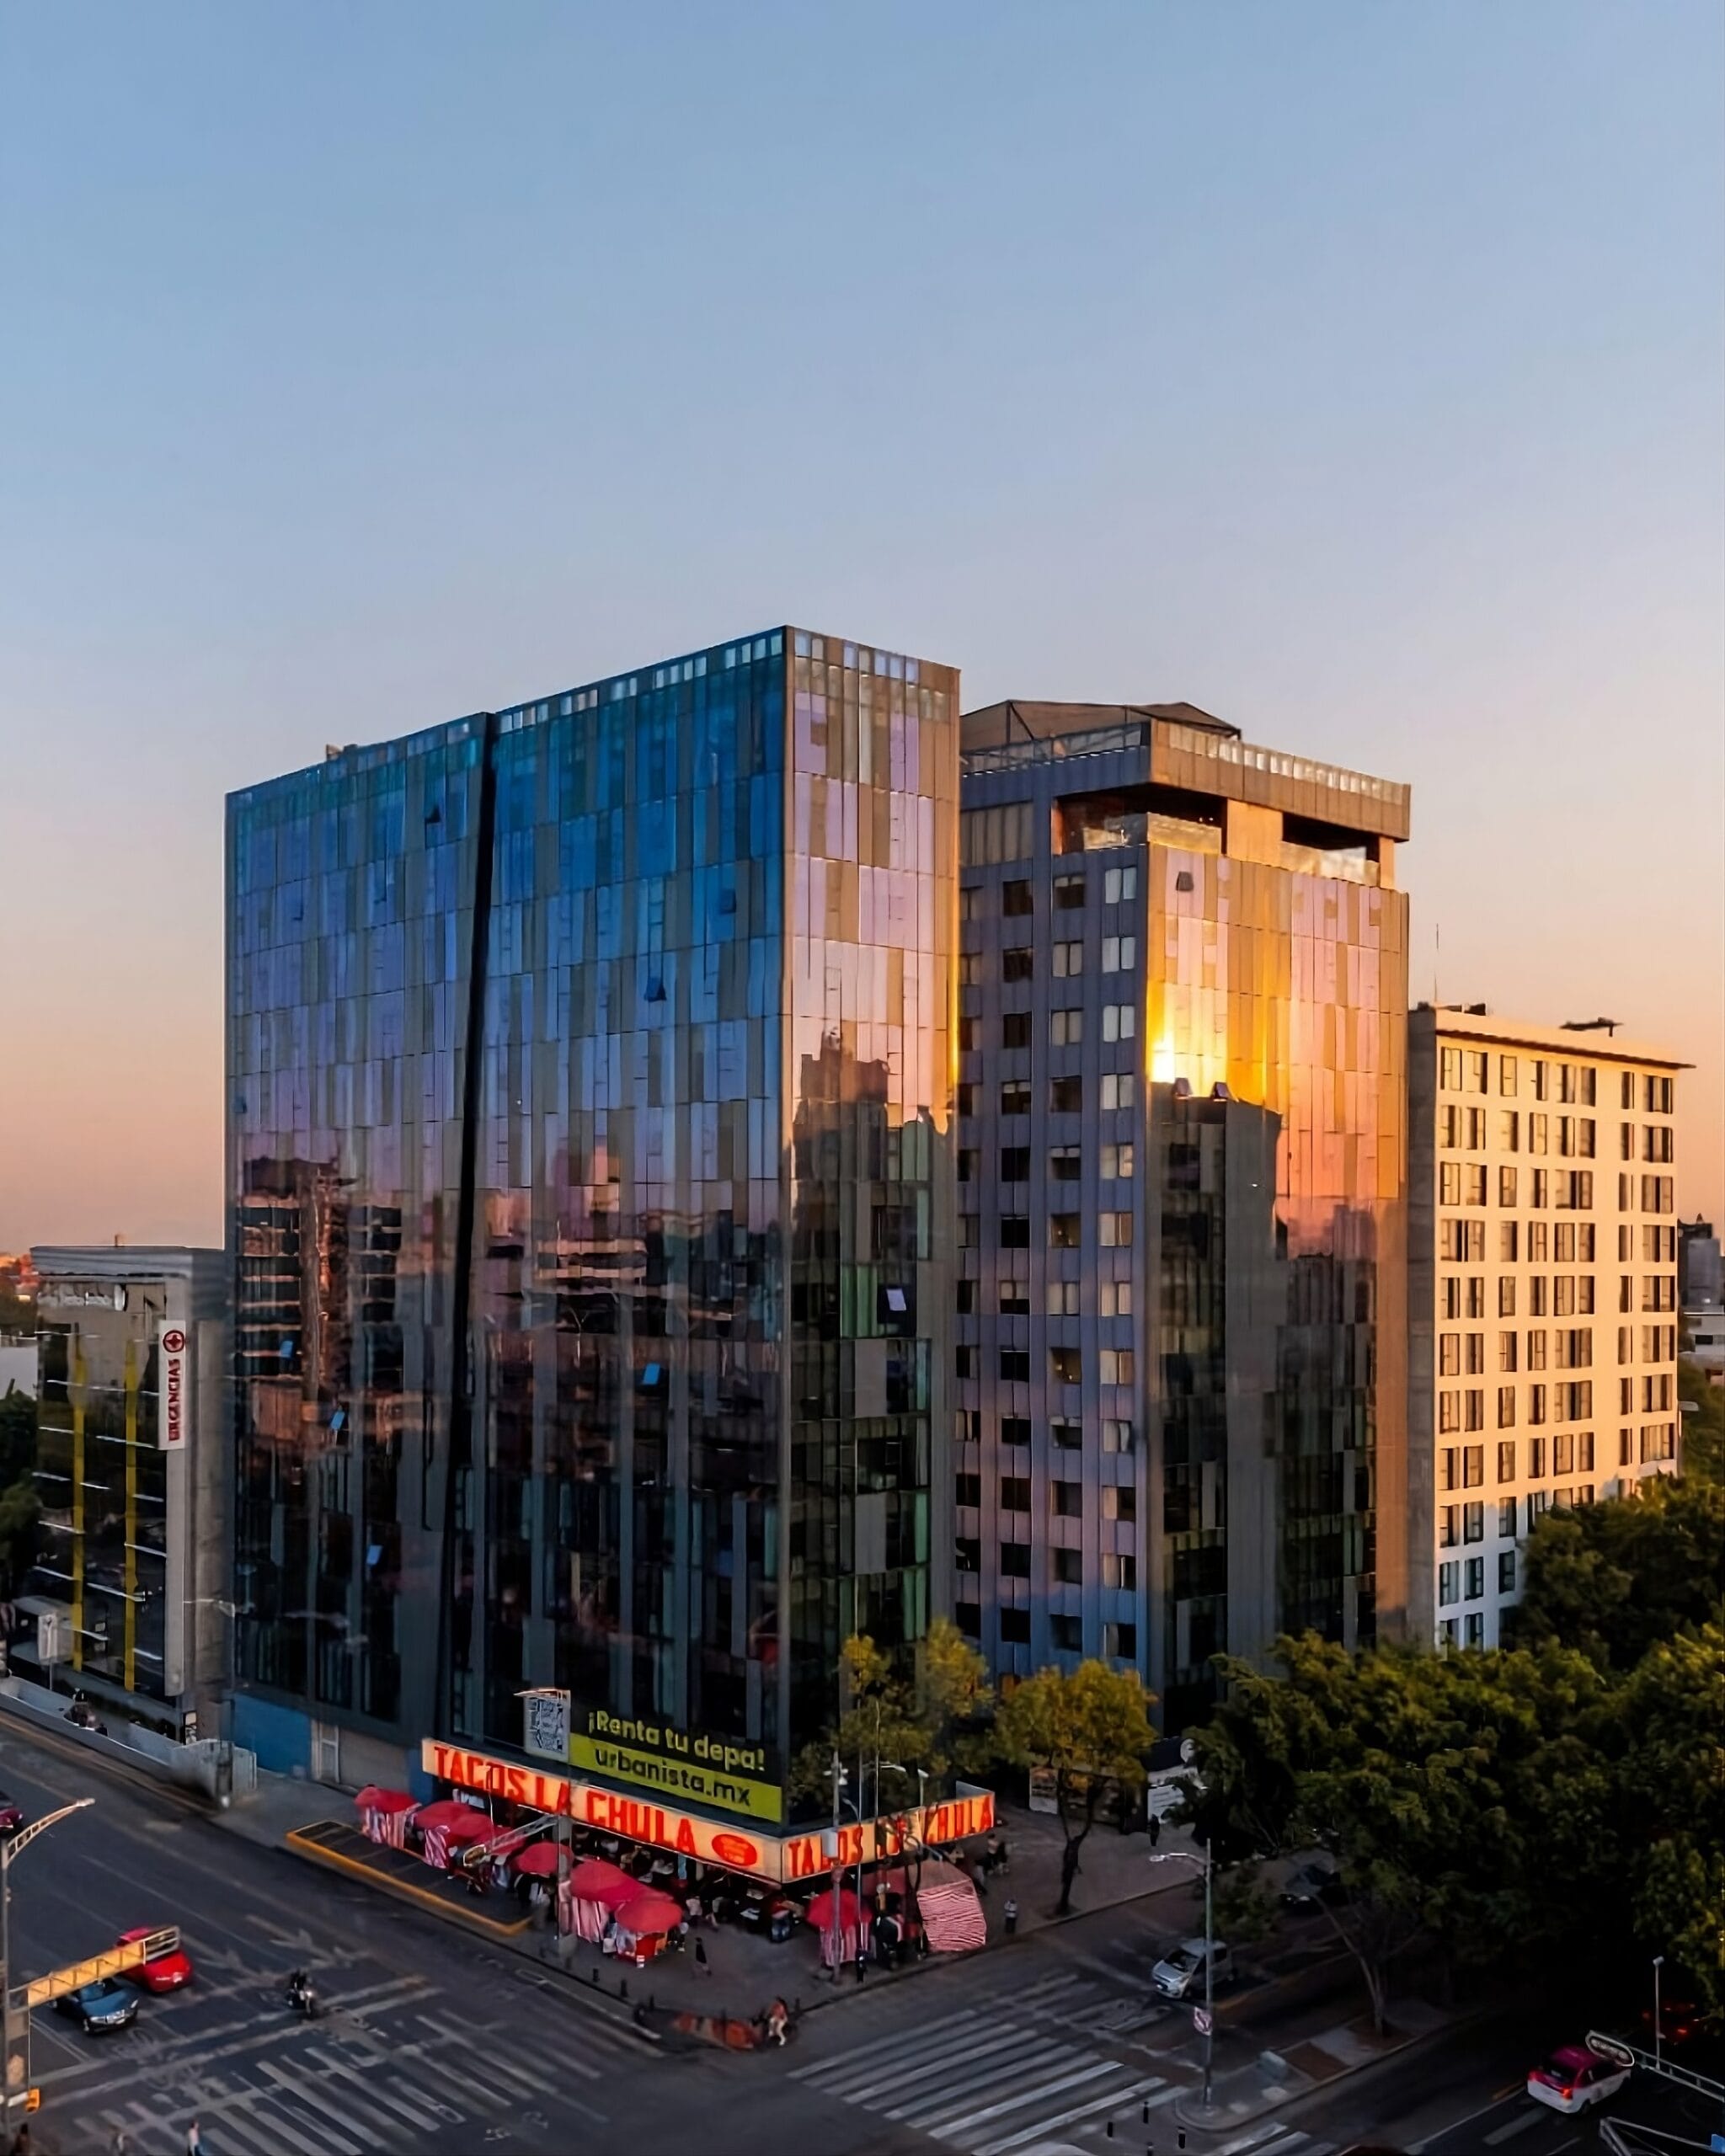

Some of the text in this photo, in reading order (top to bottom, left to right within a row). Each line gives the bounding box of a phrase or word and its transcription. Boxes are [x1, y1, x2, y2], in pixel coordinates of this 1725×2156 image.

[589, 1710, 765, 1771] ¡Renta tu depa!
[435, 1746, 529, 1805] TACOS
[536, 1776, 571, 1814] LA
[586, 1790, 697, 1856] CHULA
[595, 1748, 750, 1806] urbanista.mx
